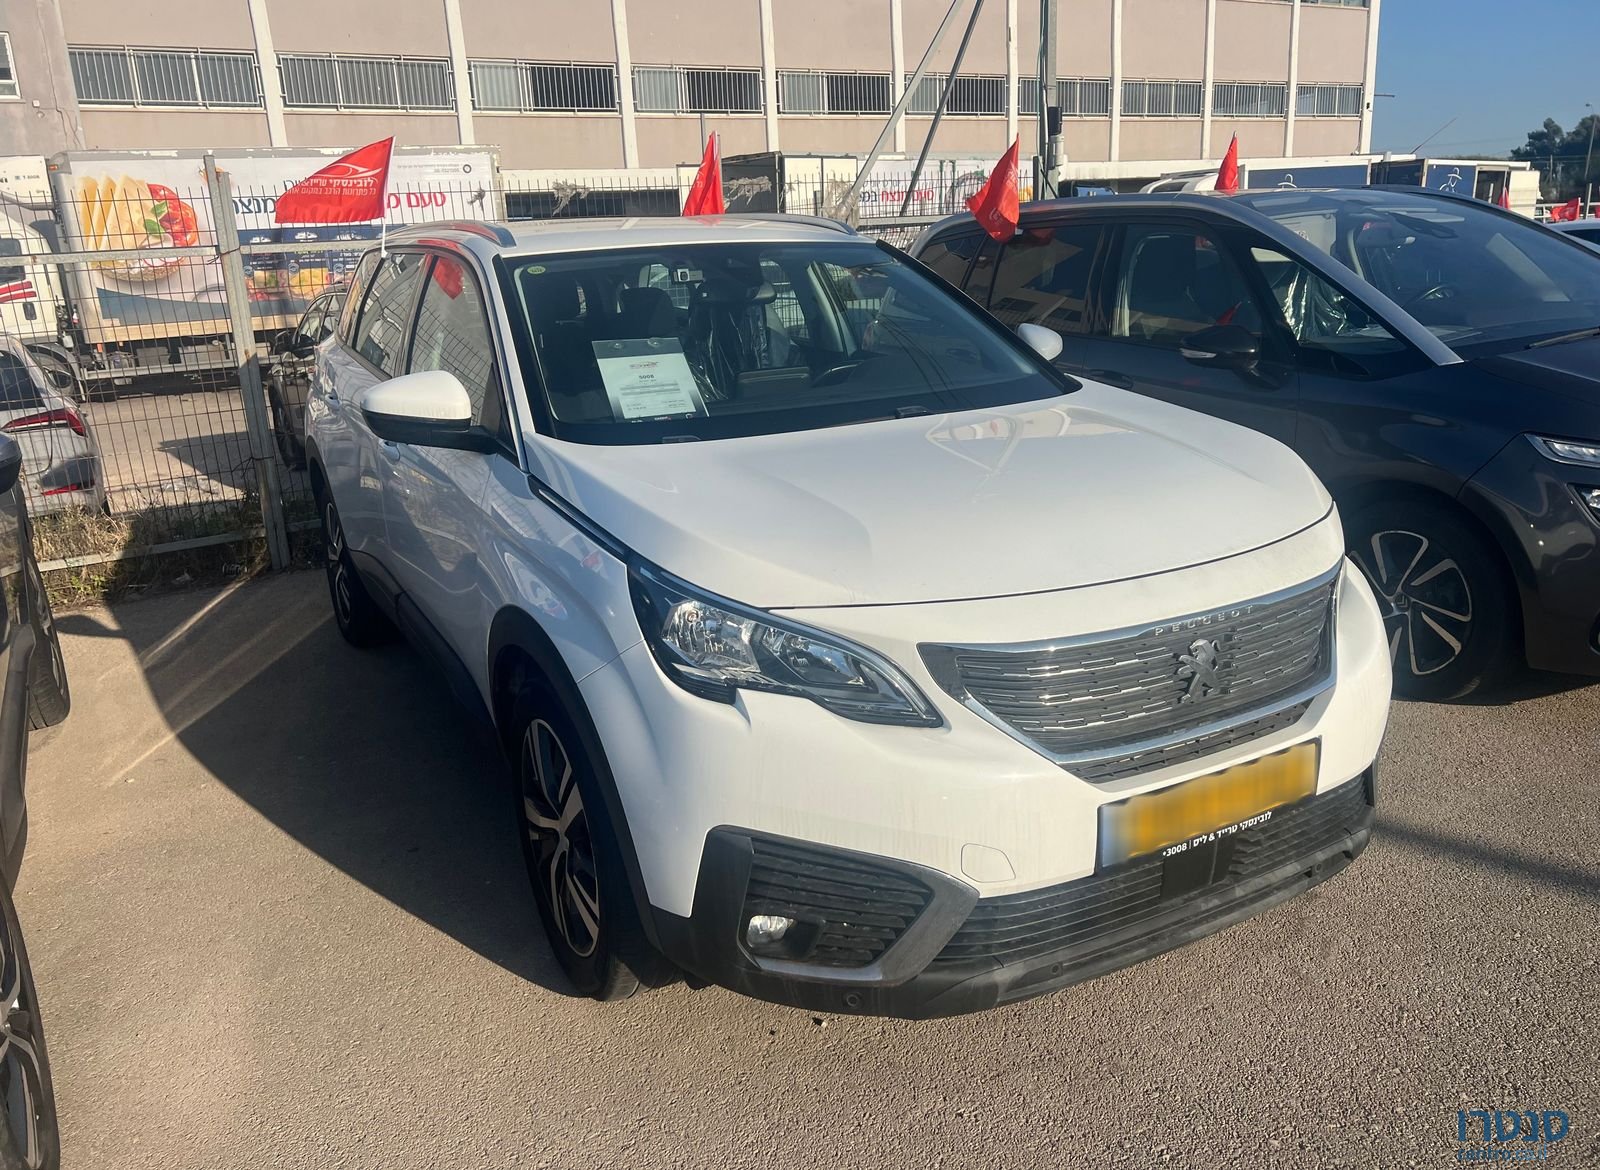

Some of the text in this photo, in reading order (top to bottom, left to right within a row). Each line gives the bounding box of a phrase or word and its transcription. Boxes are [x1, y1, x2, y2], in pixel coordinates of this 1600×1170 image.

[329, 177, 373, 188] לובינסקי
[342, 187, 368, 196] פתרונות
[406, 192, 446, 208] טעם
[1154, 605, 1253, 636] PEUGEOT
[1239, 810, 1273, 830] לובינסקי
[1208, 832, 1216, 842] &
[1216, 824, 1238, 838] טרייד
[1193, 834, 1208, 847] ליס
